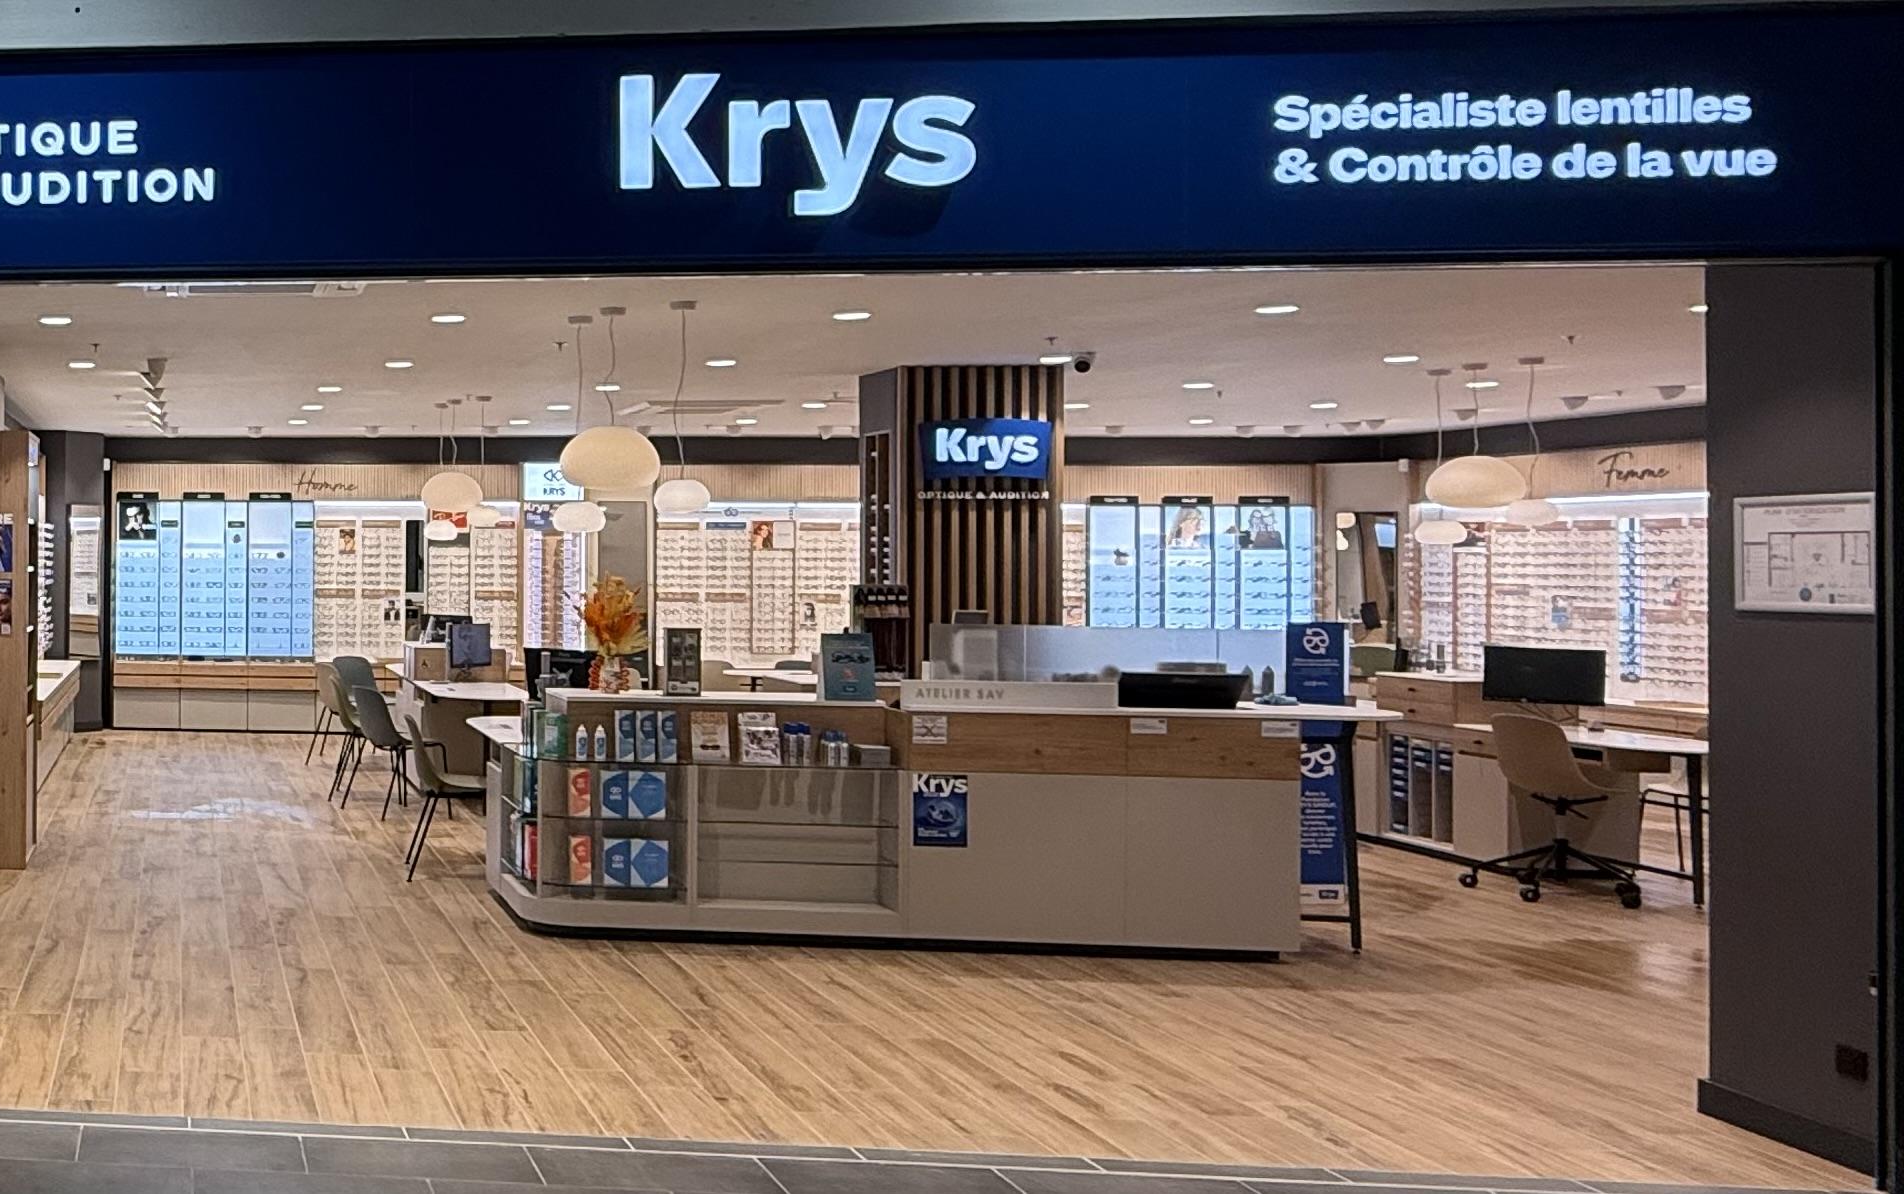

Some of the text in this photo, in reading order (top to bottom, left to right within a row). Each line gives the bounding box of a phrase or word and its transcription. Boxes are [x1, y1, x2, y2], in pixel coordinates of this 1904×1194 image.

[1273, 87, 1753, 139] Spécialiste lentilles
[619, 73, 977, 216] Krys
[1273, 142, 1778, 184] & Contrôle de la vue
[935, 427, 1040, 471] Krys
[294, 468, 358, 497] Homme
[1597, 450, 1671, 488] Femme
[917, 490, 1050, 501] OPTIQUE & AUDITION
[915, 687, 1005, 700] ATELIER SAV
[912, 773, 969, 797] Krys
